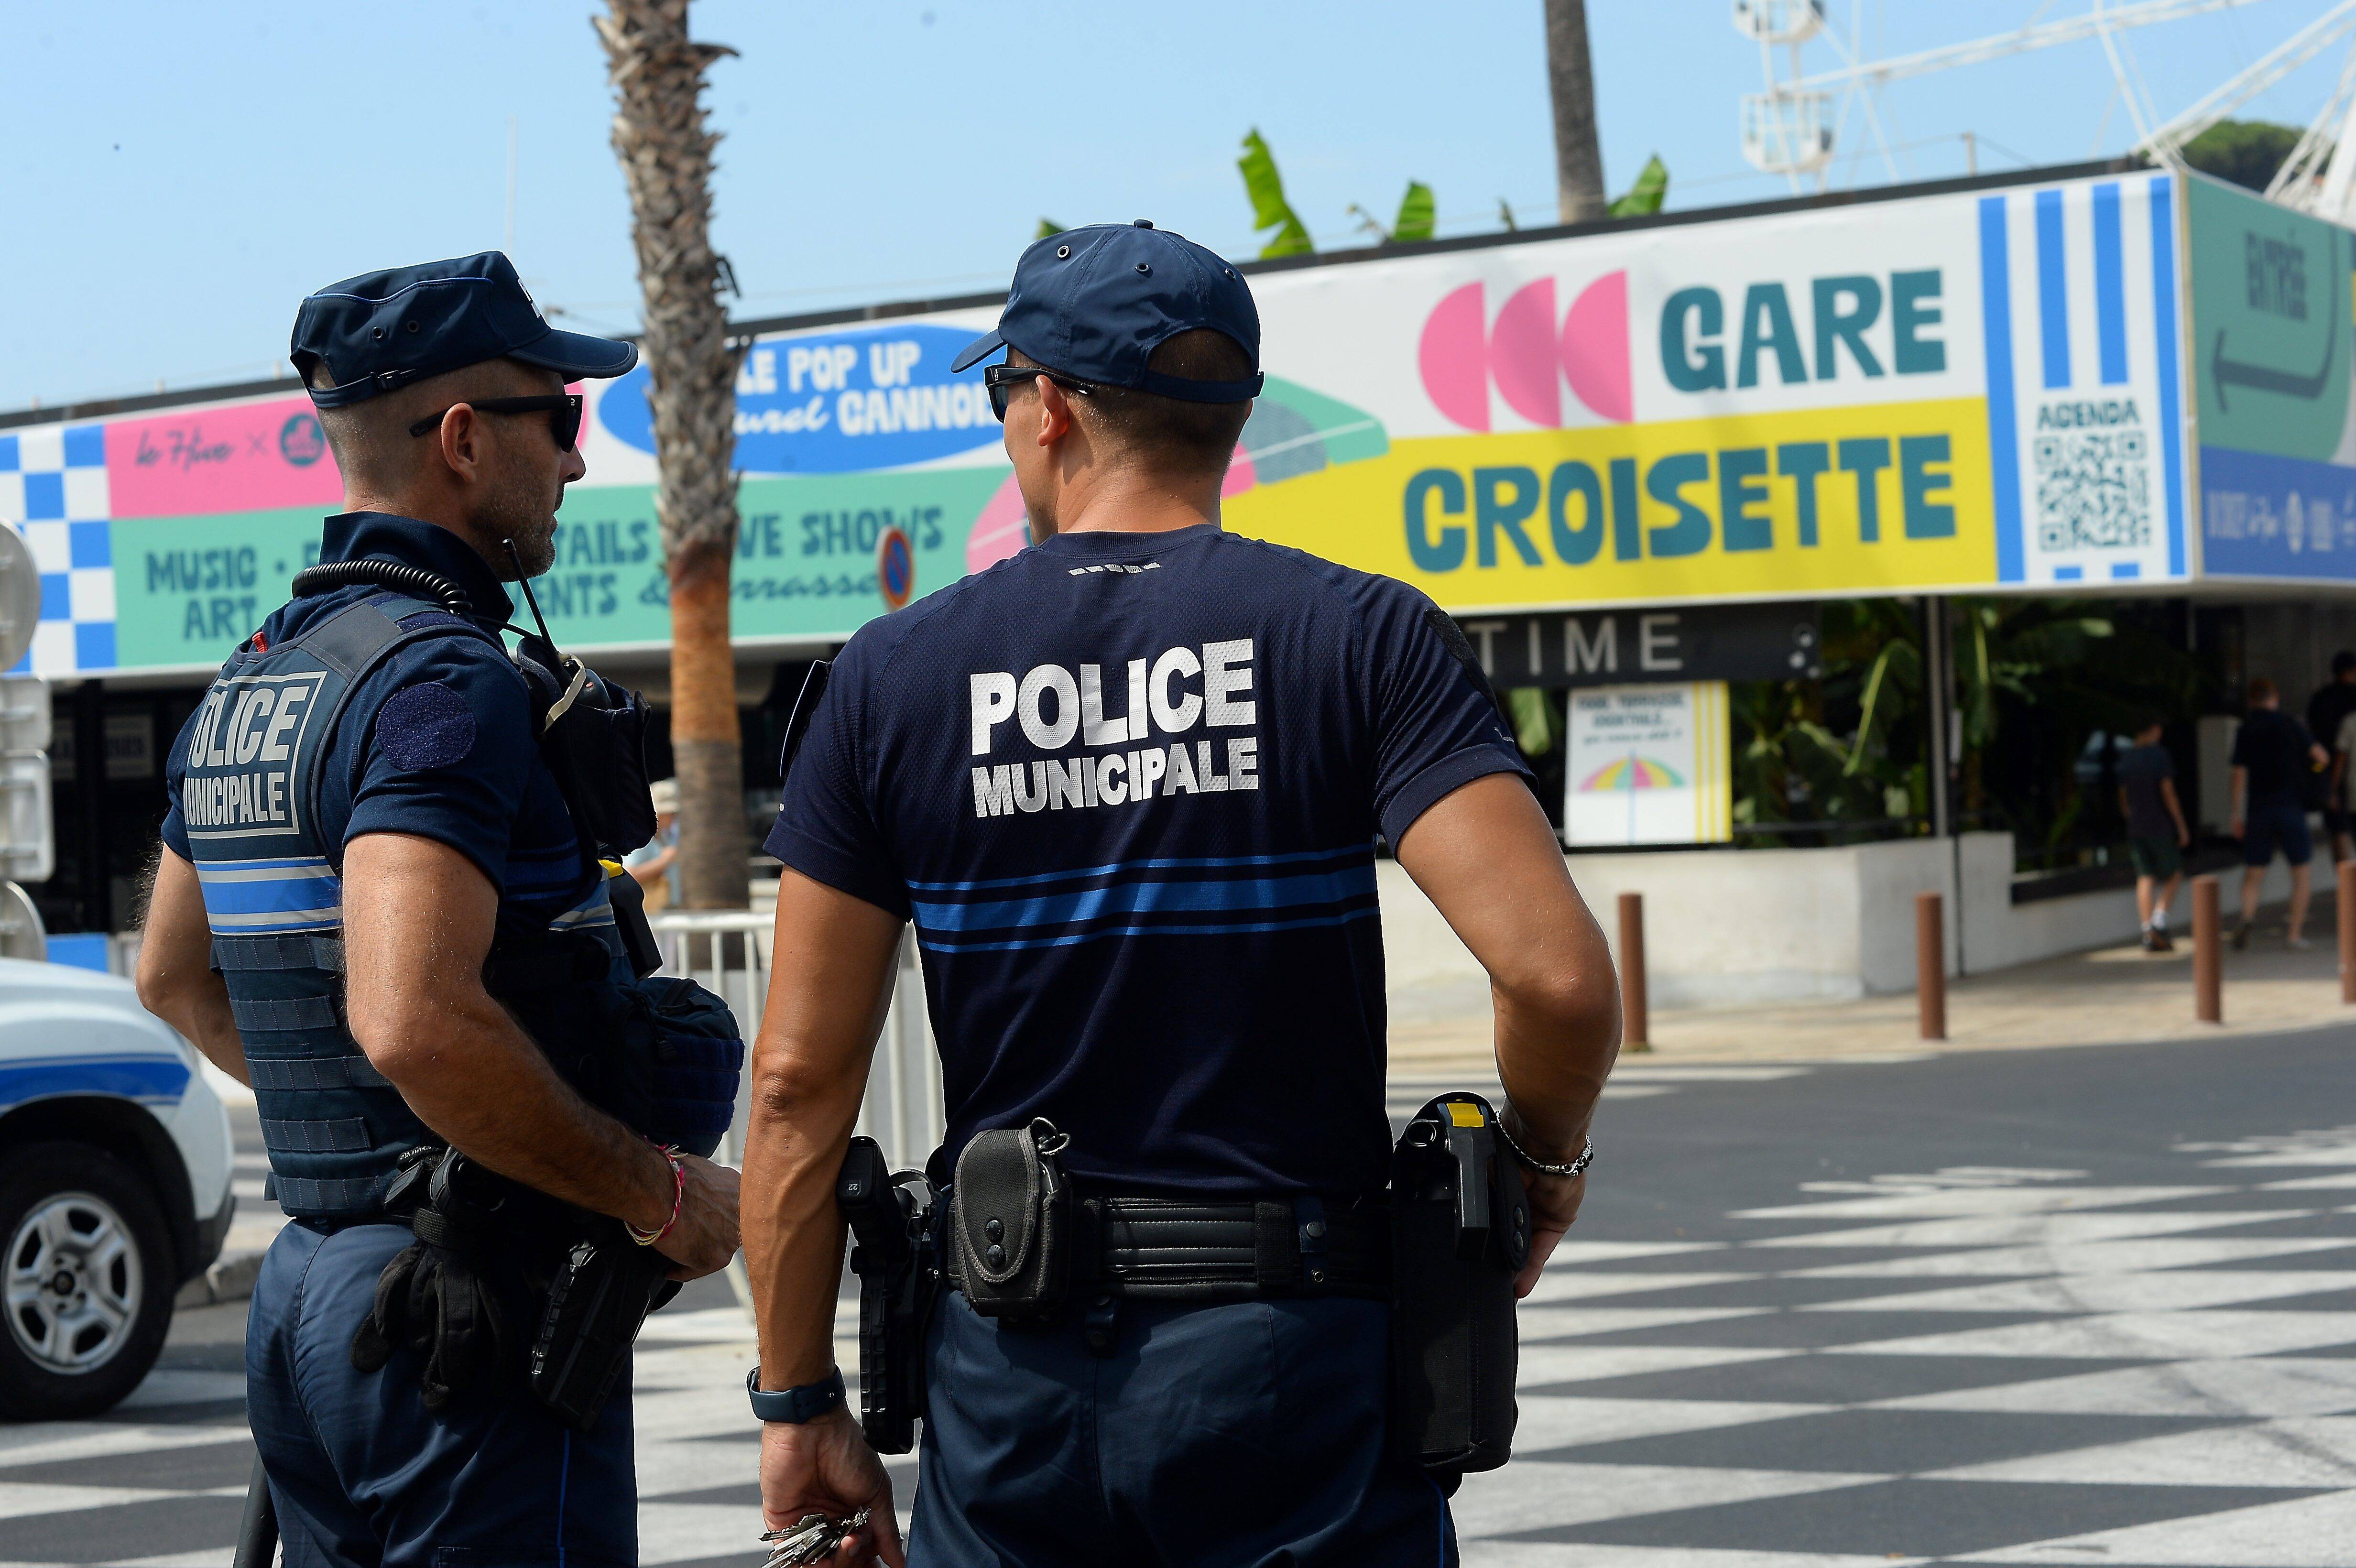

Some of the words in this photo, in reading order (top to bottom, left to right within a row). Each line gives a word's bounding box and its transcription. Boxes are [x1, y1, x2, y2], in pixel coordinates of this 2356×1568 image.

[734, 349, 777, 395] LE
[788, 345, 858, 392] POP
[869, 340, 921, 388] UP
[1658, 268, 1948, 394] GARE
[732, 395, 830, 434] urel
[837, 381, 1003, 436] CANNOI
[2037, 399, 2141, 430] AGENDA
[1402, 433, 1957, 575] CROISETTE
[144, 546, 257, 593] MUSIC
[553, 520, 649, 566] TAILS
[739, 512, 782, 558] VE
[184, 596, 259, 641] ART
[509, 574, 617, 618] ENTS
[1464, 614, 1683, 677] TIME
[187, 686, 310, 768] OLICE
[970, 638, 1256, 756] POLICE
[971, 737, 1259, 817] MUNICIPALE
